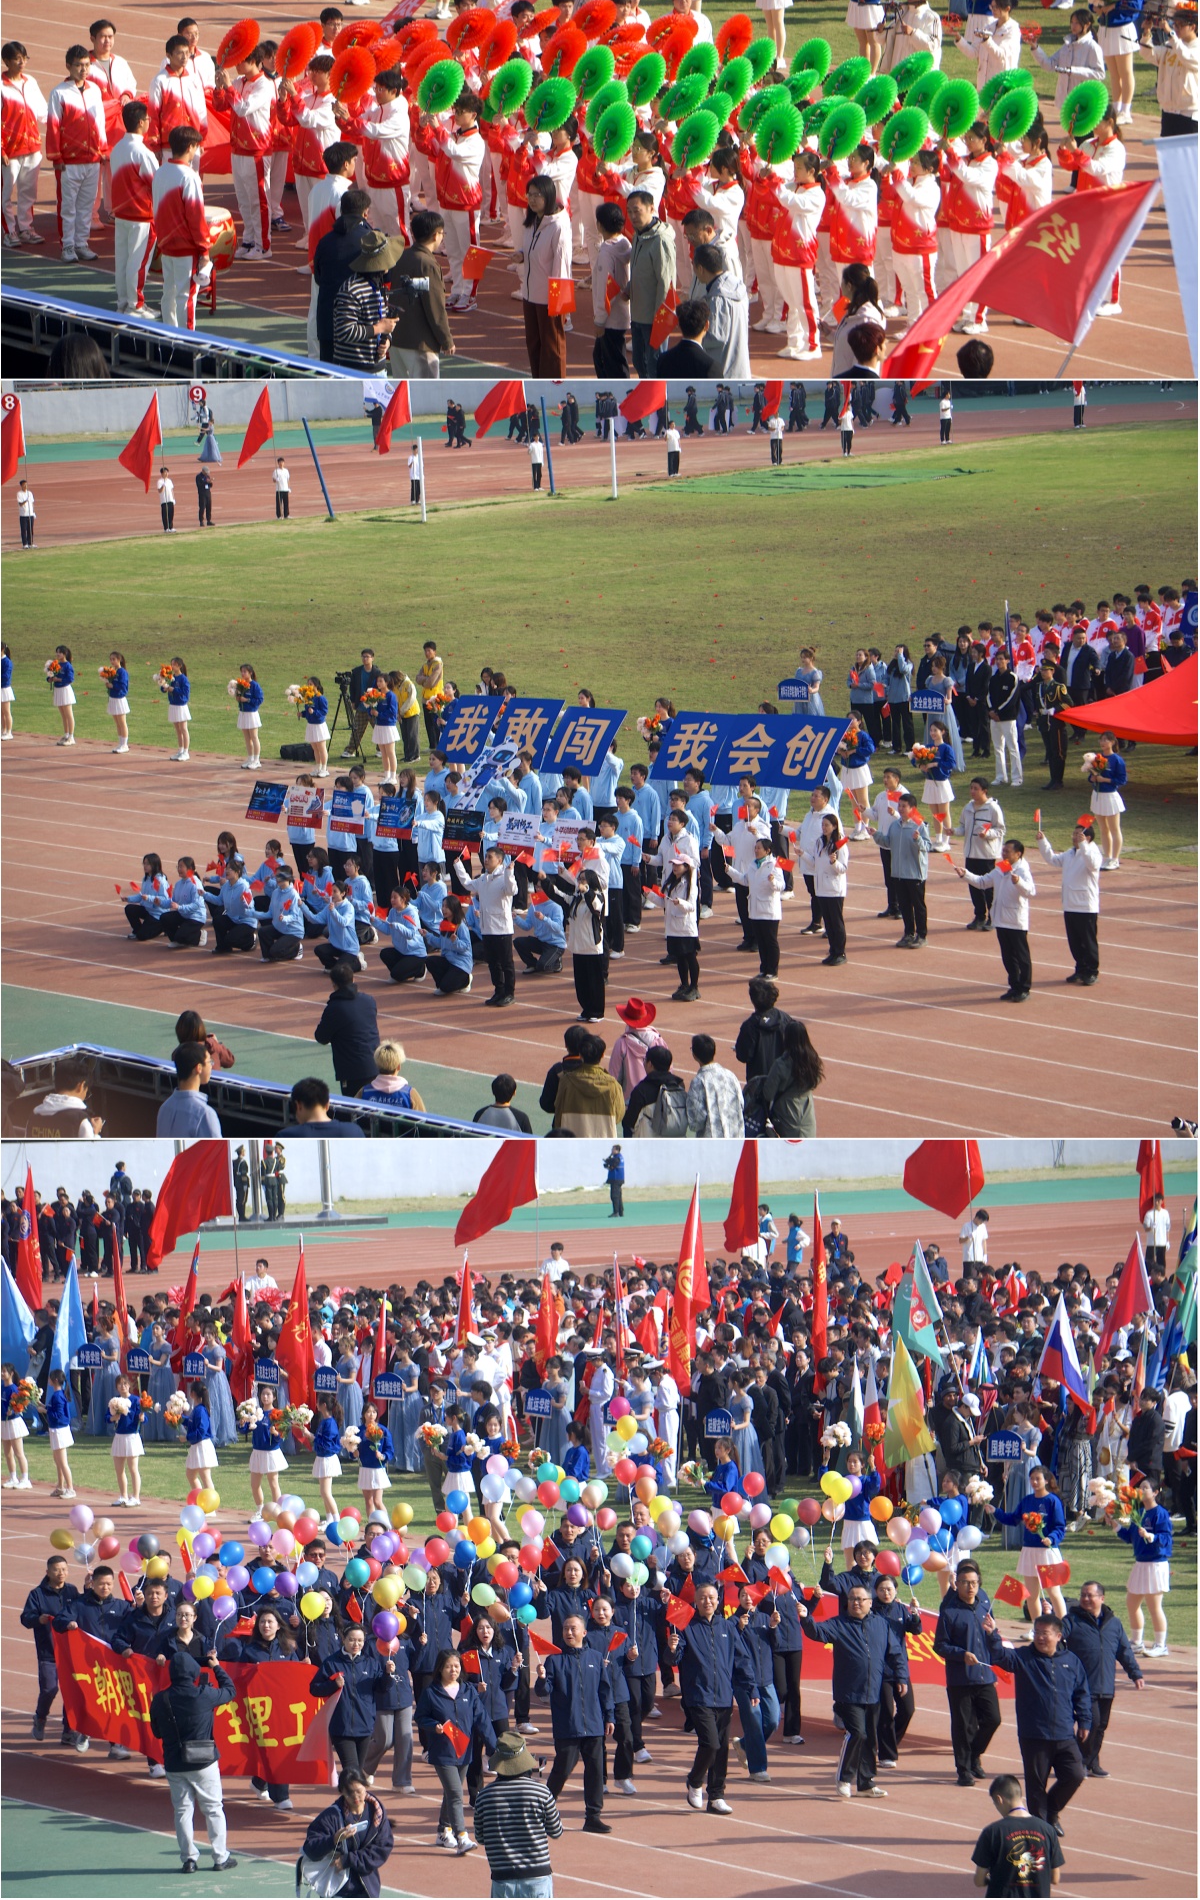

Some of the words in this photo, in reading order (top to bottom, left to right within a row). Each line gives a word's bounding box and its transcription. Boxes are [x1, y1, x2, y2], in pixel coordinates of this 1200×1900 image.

[193, 388, 203, 402] 9
[4, 396, 15, 410] 8
[913, 695, 943, 710] 安全应急学院
[31, 1127, 61, 1138] CHINA
[80, 1352, 100, 1365] 外语学院
[129, 1358, 149, 1370] 土建学院
[186, 1362, 204, 1374] 设计院
[316, 1374, 336, 1388] 经济学院
[376, 1381, 401, 1395] 交通物流学院
[527, 1397, 550, 1413] 航运学院
[707, 1418, 730, 1434] 硅酸盐中心
[990, 1439, 1020, 1457] 国教学院
